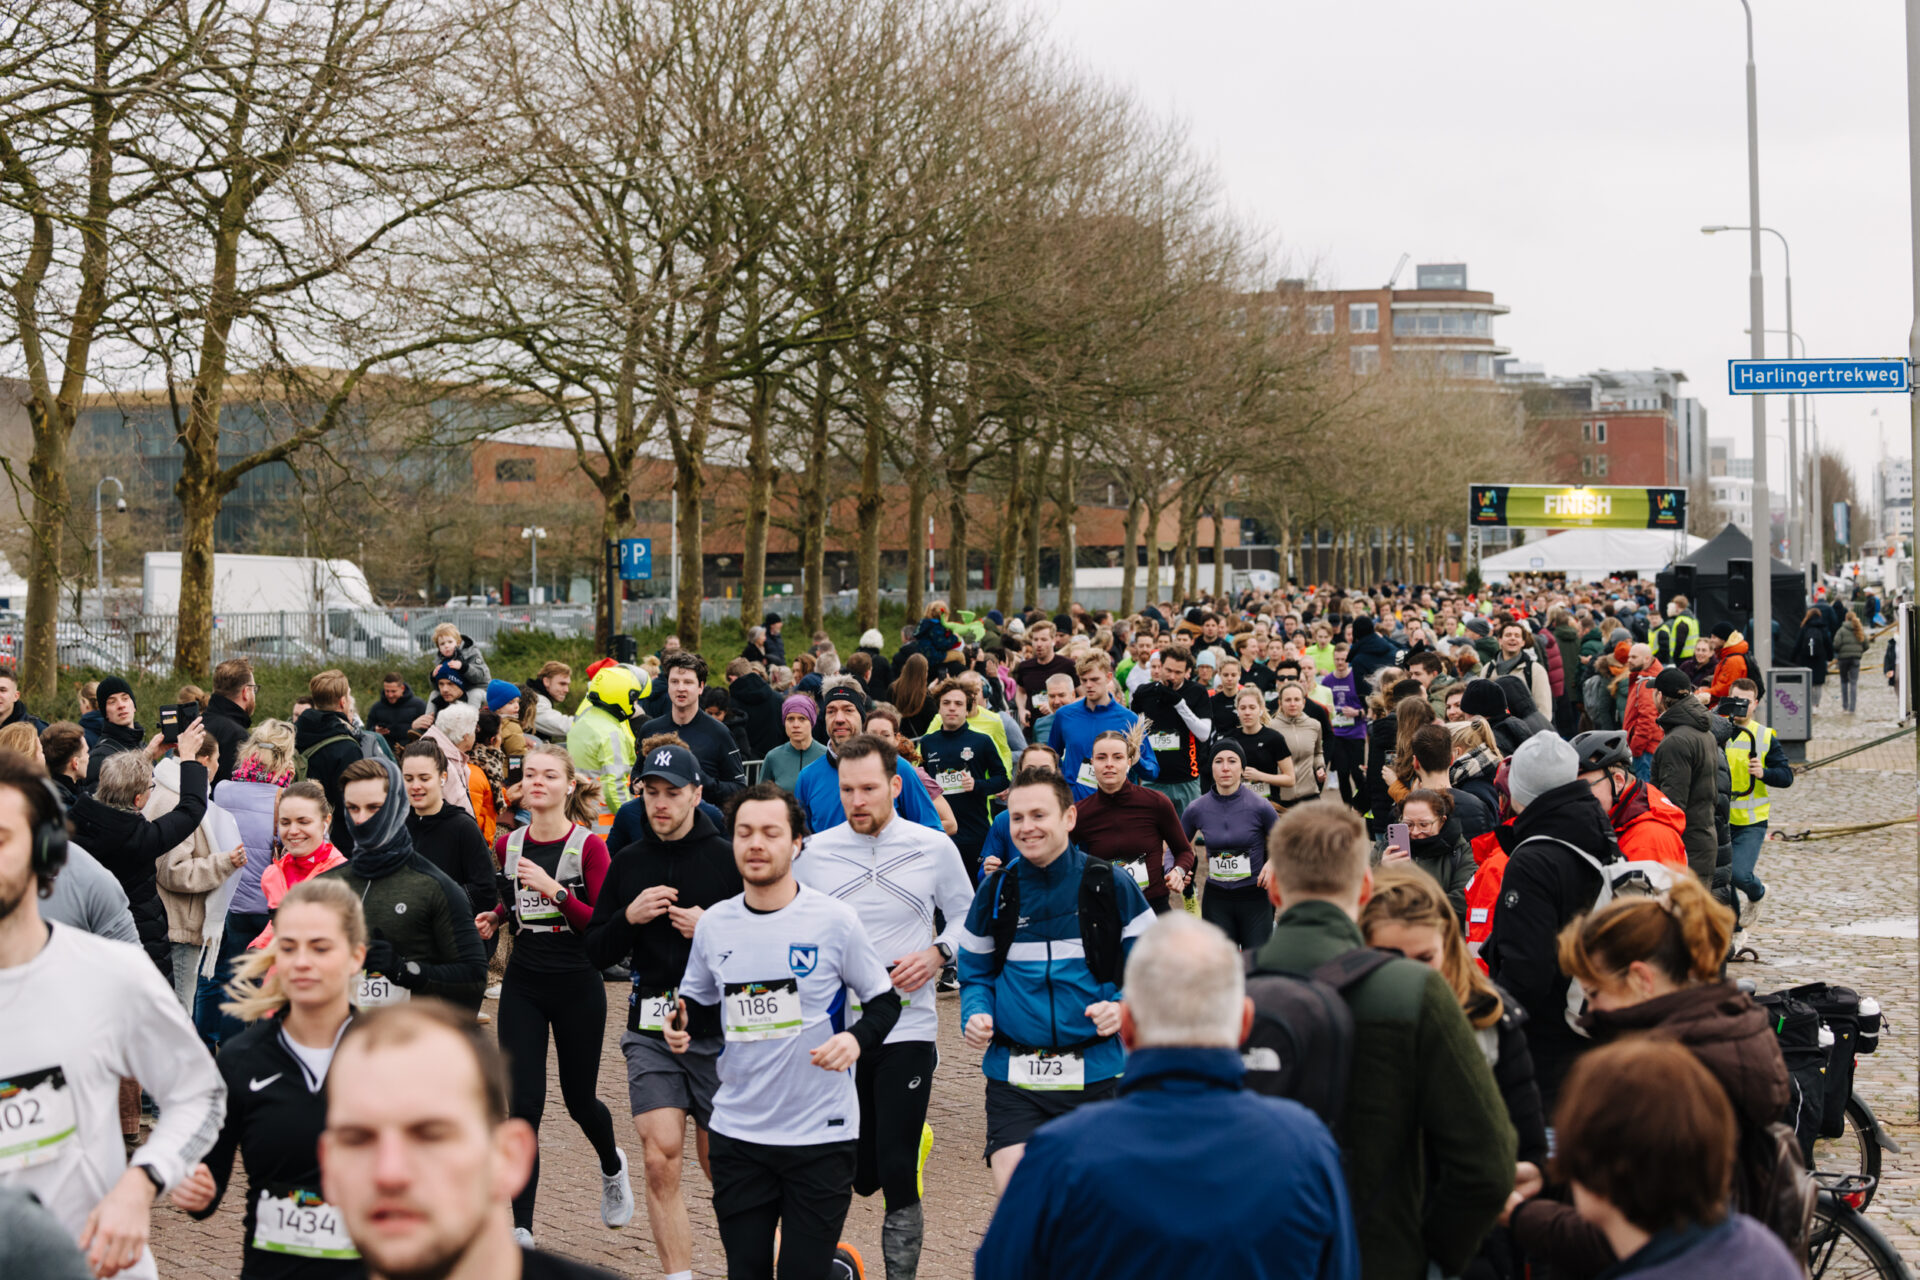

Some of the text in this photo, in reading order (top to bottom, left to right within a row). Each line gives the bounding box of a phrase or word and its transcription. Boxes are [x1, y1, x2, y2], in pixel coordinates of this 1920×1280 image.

[1741, 366, 1899, 388] Harlingertrekweg
[1543, 494, 1612, 515] FINISH
[633, 542, 647, 565] P
[1215, 859, 1239, 870] 1416
[737, 996, 778, 1017] 1186
[1028, 1060, 1063, 1076] 1173
[277, 1207, 336, 1236] 1434
